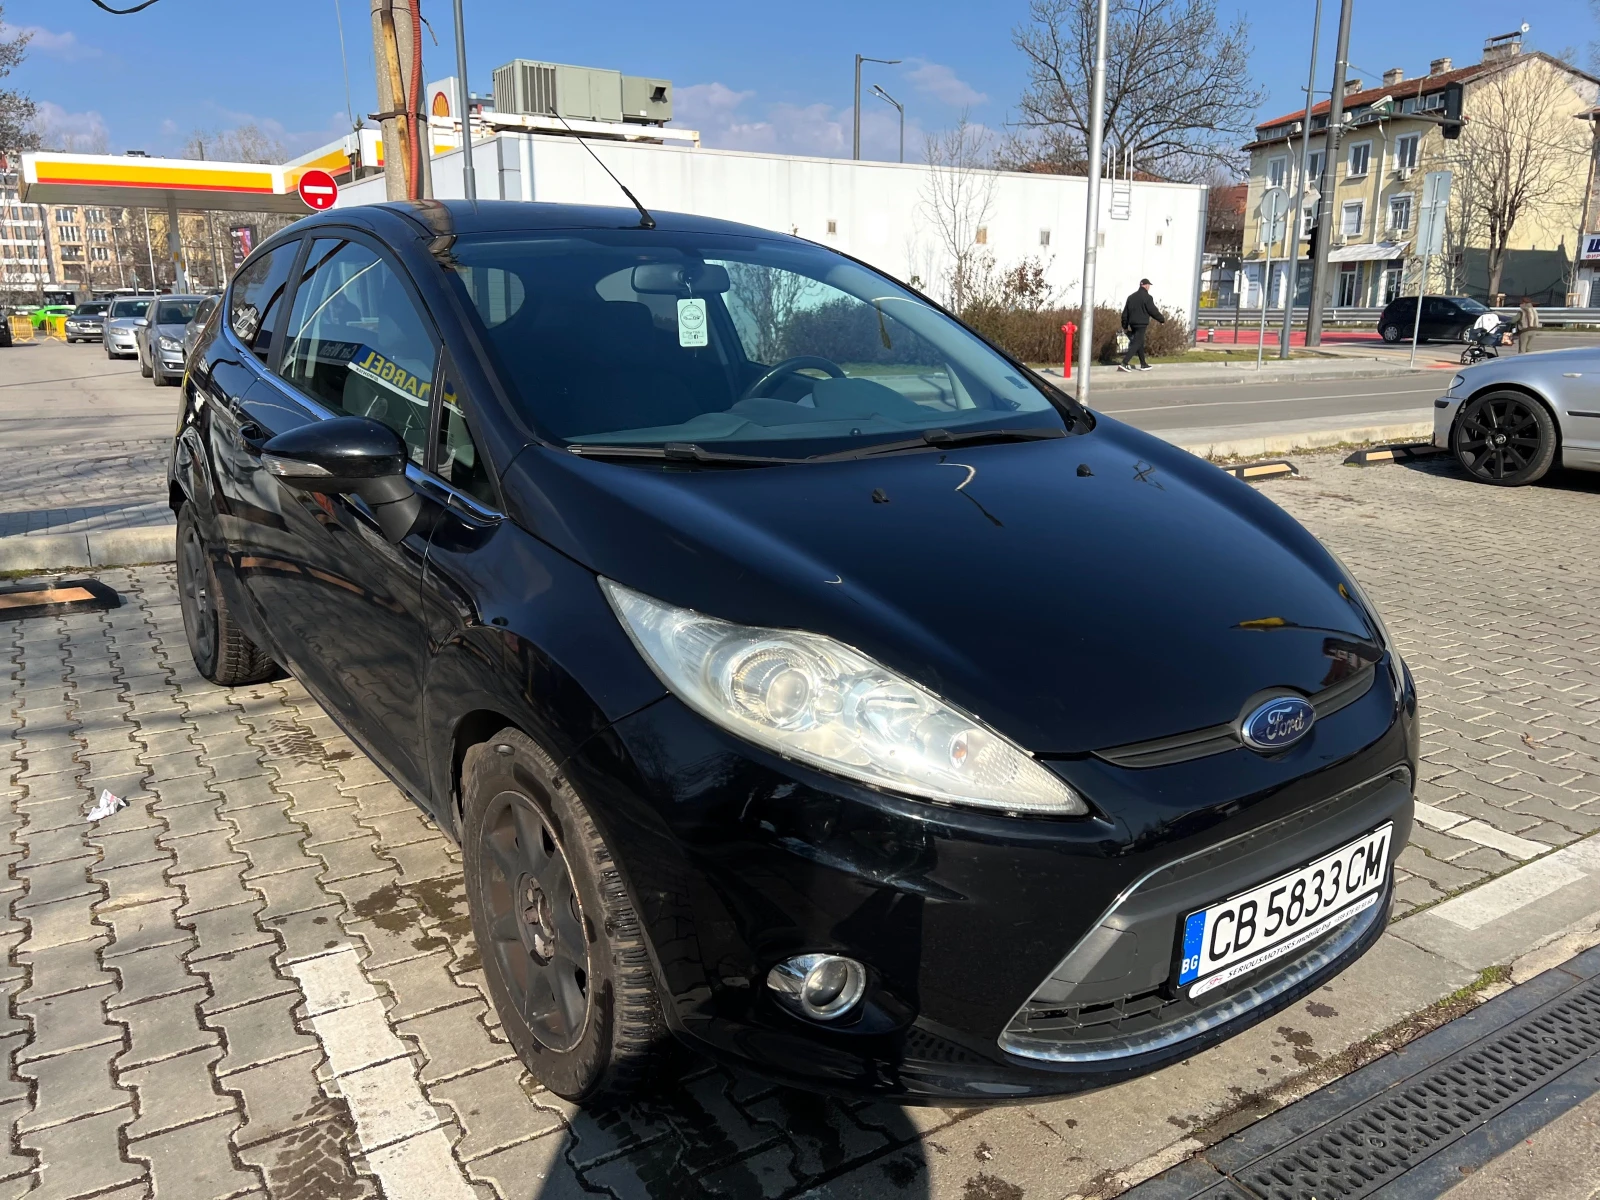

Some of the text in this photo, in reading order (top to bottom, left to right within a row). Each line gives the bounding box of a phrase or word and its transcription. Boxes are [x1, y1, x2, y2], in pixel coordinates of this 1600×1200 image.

[1266, 706, 1305, 740] Ford
[1209, 835, 1386, 962] CB 5833 CM
[1180, 955, 1198, 975] BG
